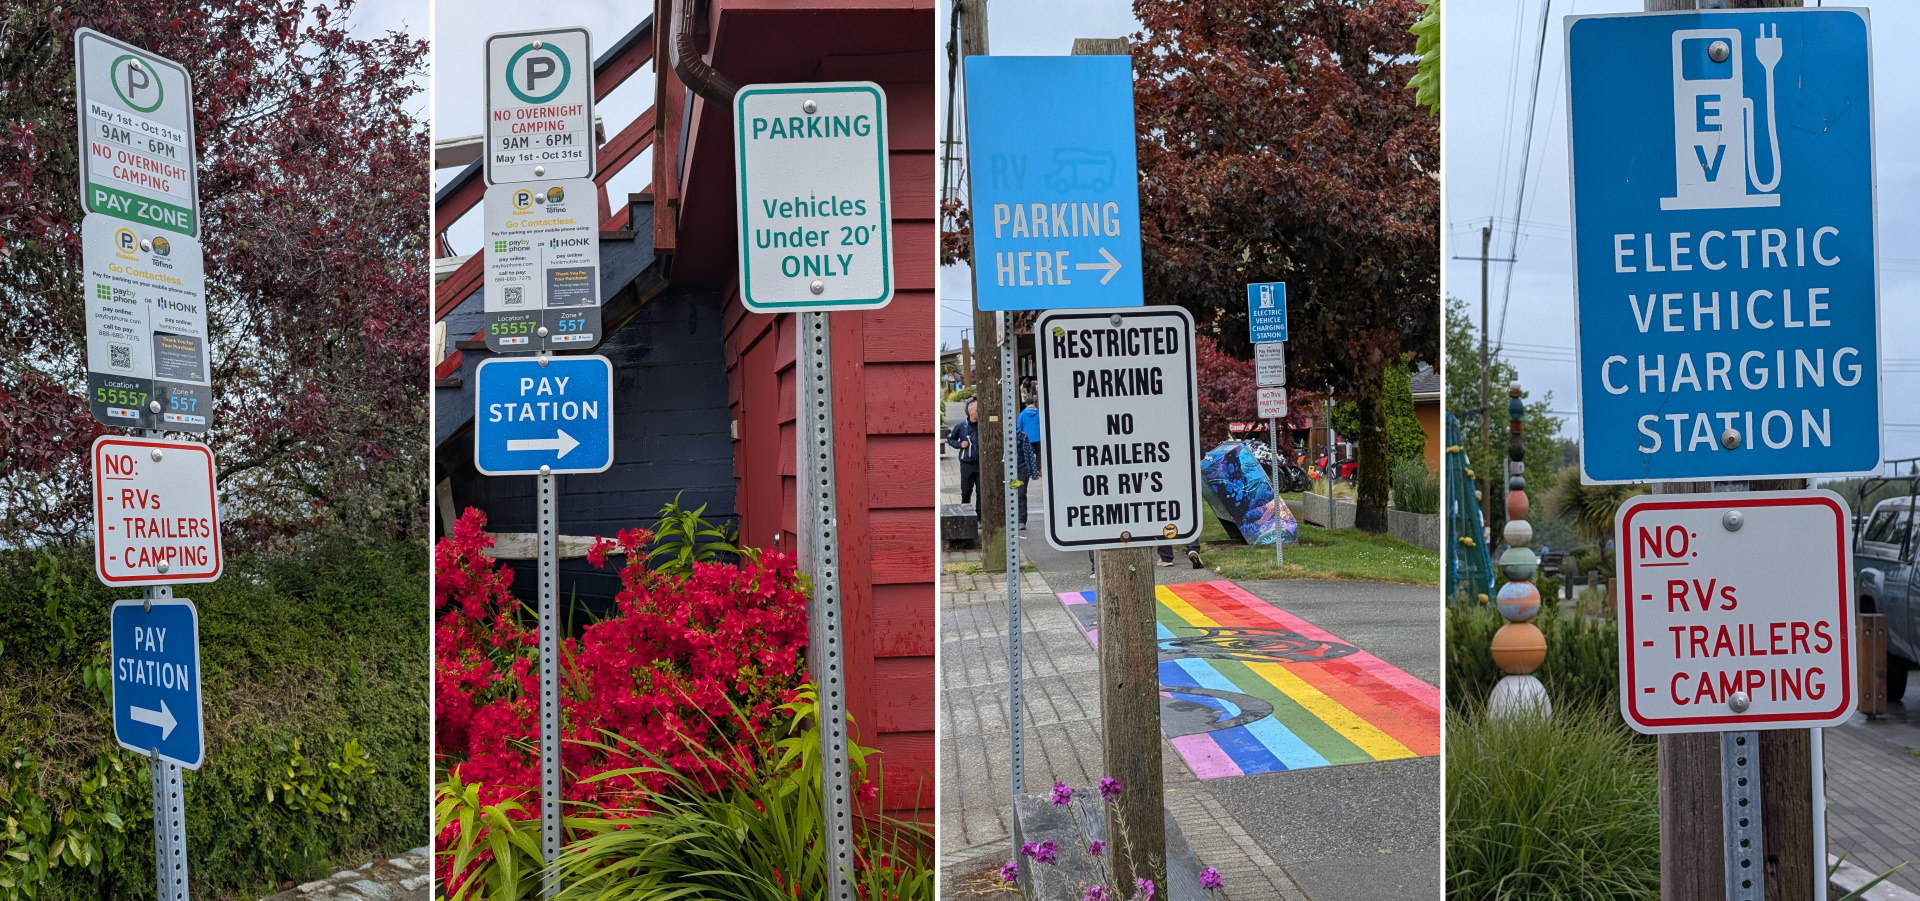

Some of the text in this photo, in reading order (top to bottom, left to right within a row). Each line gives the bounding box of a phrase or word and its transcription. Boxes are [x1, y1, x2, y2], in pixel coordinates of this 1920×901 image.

[128, 64, 149, 98] P
[527, 57, 556, 90] P
[92, 105, 113, 121] May
[117, 115, 132, 126] 1st
[142, 122, 158, 135] Oct
[162, 129, 181, 142] 31st
[494, 105, 582, 121] NO OVERNIGHT
[512, 120, 565, 134] CAMPING
[753, 115, 871, 139] PARKING
[102, 125, 130, 145] 9AM
[149, 140, 174, 158] 6PM
[503, 137, 528, 149] 9AM
[546, 134, 572, 146] 6PM
[93, 143, 186, 181] NO OVERNIGHT
[496, 155, 515, 163] May
[113, 166, 170, 192] CAMPING
[991, 154, 1027, 191] RV
[96, 190, 188, 228] PAY ZONE
[763, 196, 866, 218] Vehicles
[521, 218, 576, 227] Contactless.
[993, 202, 1120, 239] PARKING
[561, 238, 589, 246] HONK
[756, 225, 876, 249] Under 20'
[1614, 226, 1840, 273] ELECTRIC
[109, 263, 183, 285] Go Contactless.
[782, 254, 853, 277] ONLY
[997, 251, 1071, 287] HERE
[113, 288, 136, 298] payby
[114, 296, 137, 305] phone
[169, 301, 197, 314] HONK
[1629, 288, 1831, 332] VEHICLE
[491, 322, 536, 335] 55557
[559, 319, 585, 332] 557
[1053, 327, 1178, 359] RESTRICTED
[1073, 367, 1163, 398] PARKING
[1601, 347, 1862, 394] CHARGING
[104, 380, 133, 389] Location
[521, 377, 569, 396] PAY
[97, 388, 147, 406] 55557
[171, 396, 197, 411] 557
[489, 401, 598, 422] STATION
[1107, 413, 1133, 435] NO
[1638, 408, 1831, 454] STATION
[105, 454, 138, 476] NO:
[1073, 441, 1170, 467] TRAILERS
[1083, 472, 1163, 496] OR RV'S
[122, 489, 160, 510] RVs
[1067, 500, 1180, 528] PERMITTED
[123, 518, 209, 539] TRAILERS
[1639, 525, 1697, 559] NO:
[125, 547, 208, 568] CAMPING
[1668, 579, 1737, 612] RVs
[135, 626, 166, 652] PAY
[1669, 621, 1832, 658] TRAILERS
[119, 658, 189, 692] STATION
[1671, 667, 1825, 705] CAMPING
